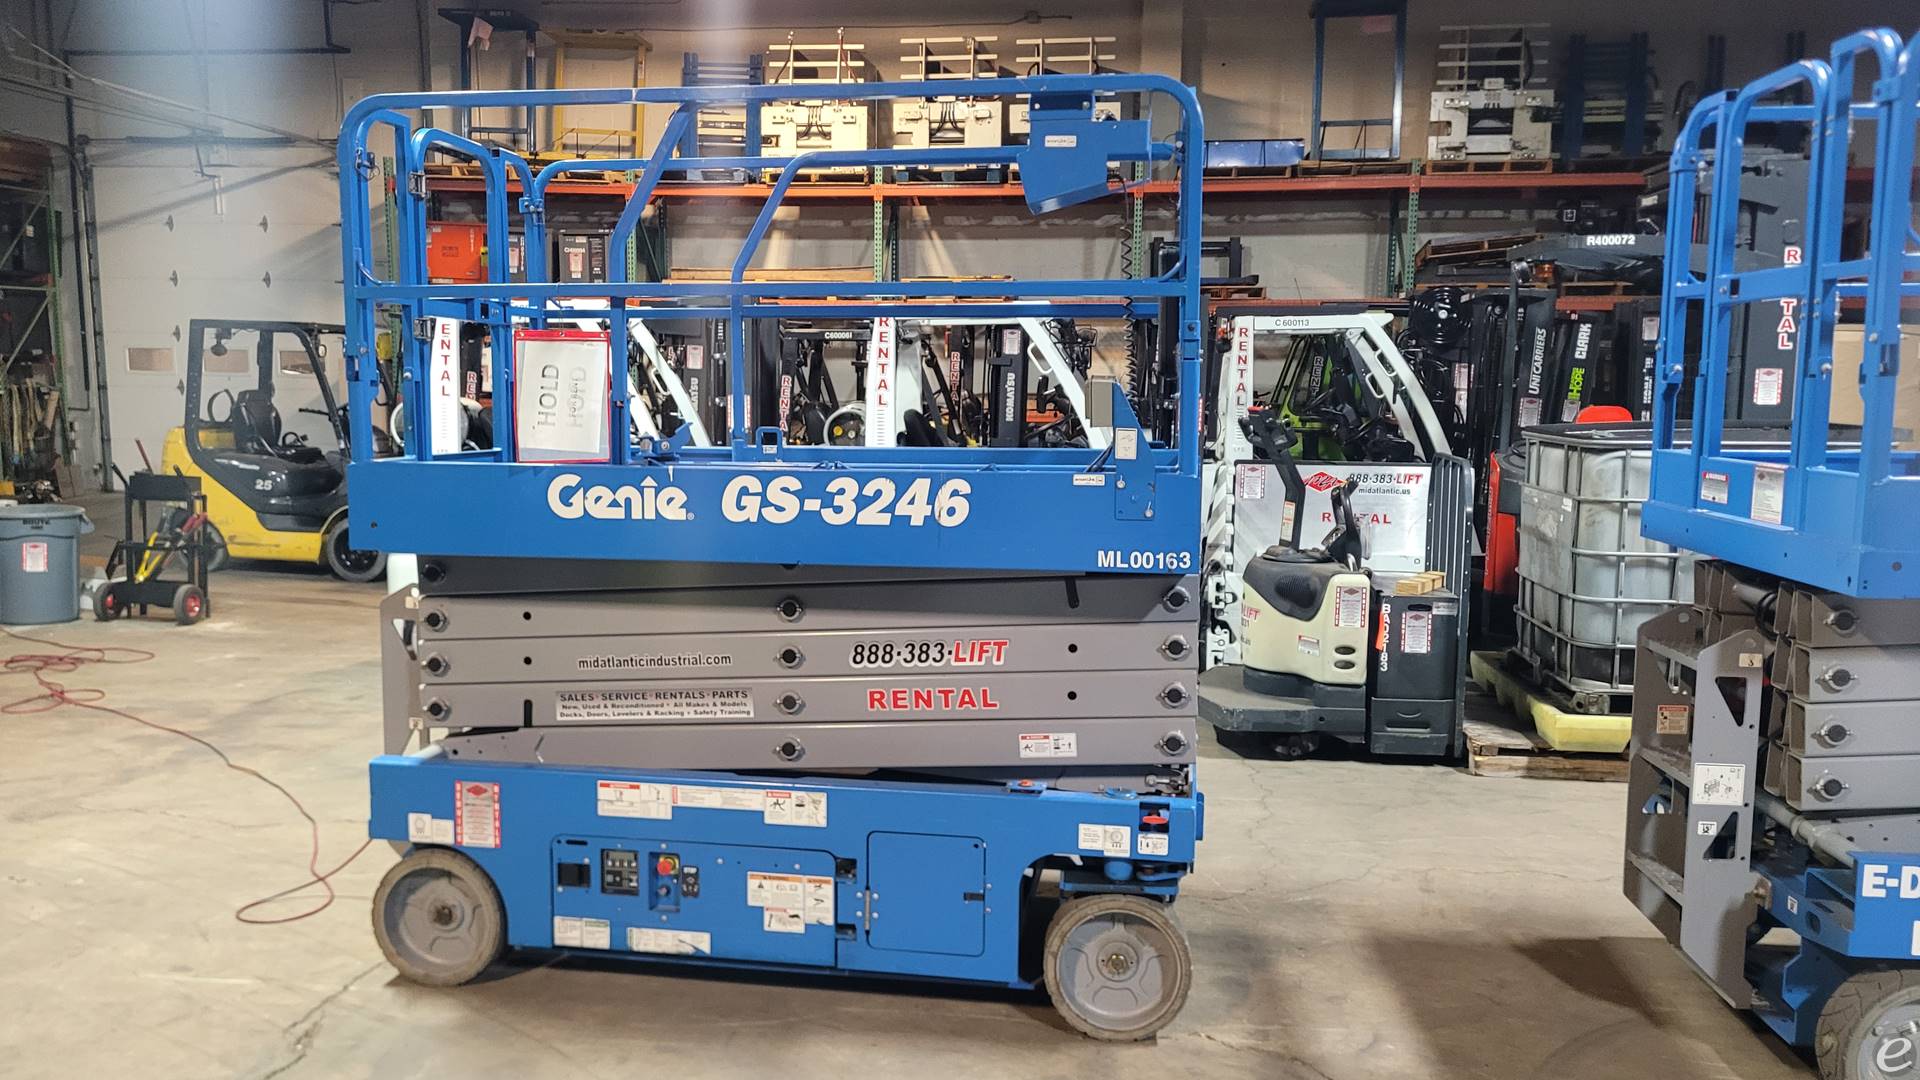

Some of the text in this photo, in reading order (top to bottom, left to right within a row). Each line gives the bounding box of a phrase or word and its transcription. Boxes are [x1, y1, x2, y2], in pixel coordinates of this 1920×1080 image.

[1586, 234, 1636, 246] R400072
[1777, 247, 1801, 349] RTAL
[440, 323, 451, 397] ENTAL
[877, 317, 889, 406] RENTAL
[1574, 323, 1592, 360] CLARK
[950, 352, 961, 401] RENTA
[1235, 327, 1249, 406] RENTAL
[1311, 355, 1324, 395] RENT
[537, 364, 560, 427] HOLD
[688, 377, 699, 412] ATSU
[779, 375, 792, 432] RENTA
[1005, 372, 1016, 422] KOMATSU
[255, 479, 273, 491] 25
[721, 475, 972, 528] GS-3246
[1358, 487, 1411, 495] midatlantic.us
[1096, 550, 1191, 570] ML00163
[577, 653, 732, 669] midatlanticindustrial.com
[559, 690, 748, 702] SALES SERVICE RENTALS PARTS
[867, 688, 999, 710] RENTAL
